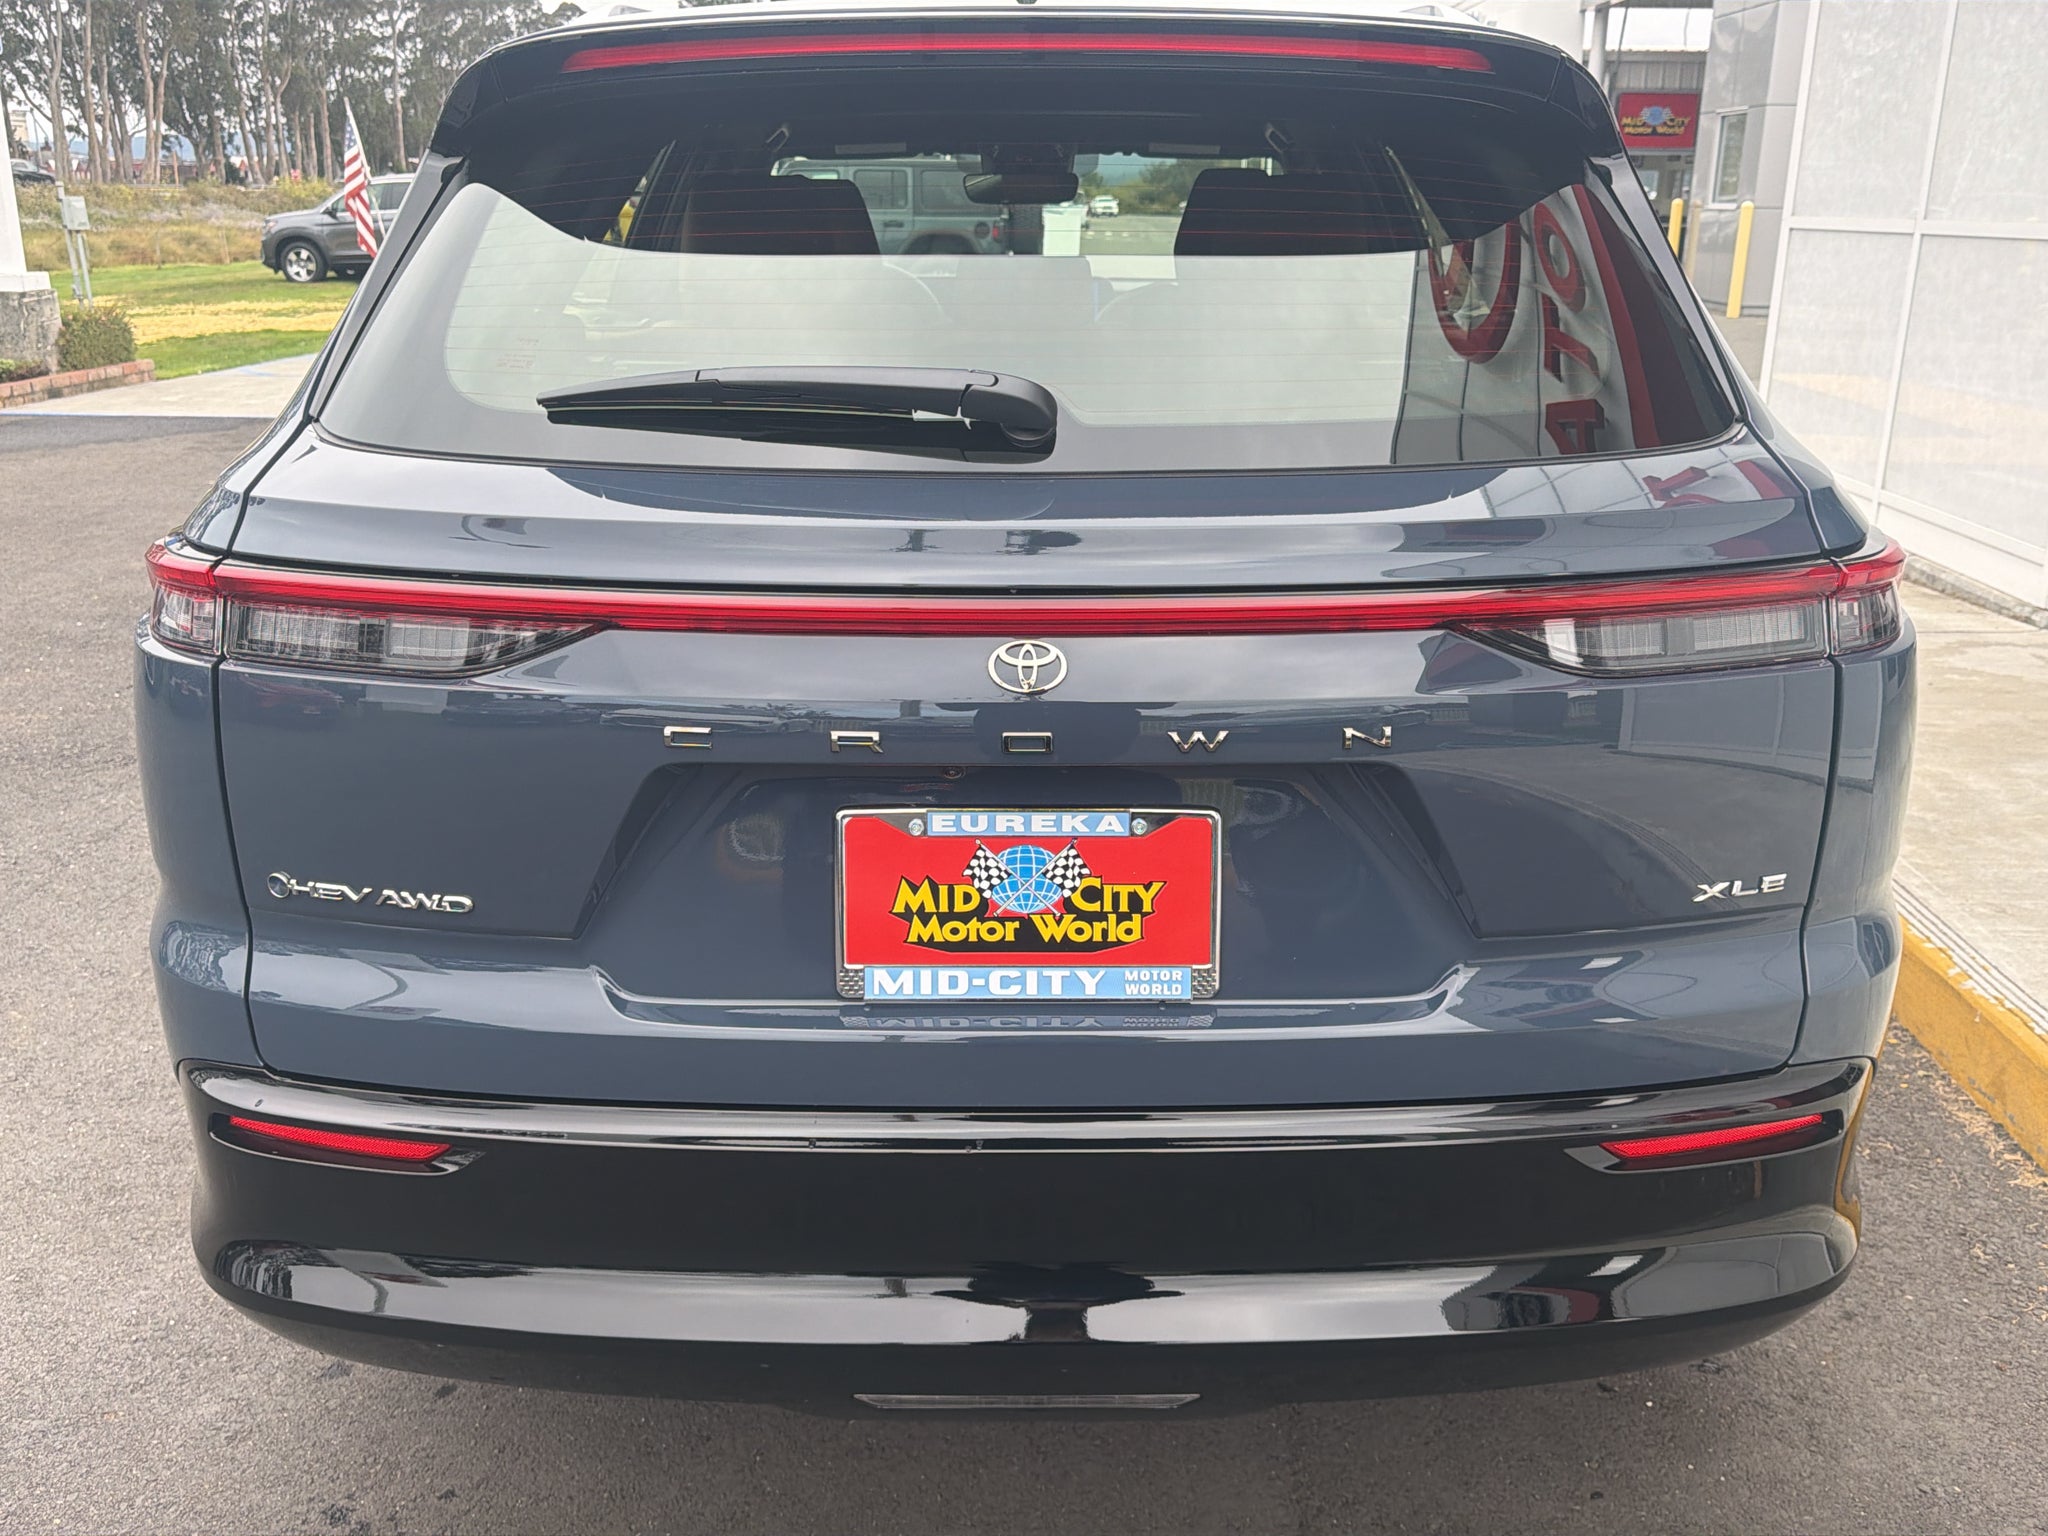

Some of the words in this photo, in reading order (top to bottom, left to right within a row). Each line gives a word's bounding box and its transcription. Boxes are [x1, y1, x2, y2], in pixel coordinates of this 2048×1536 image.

[663, 726, 1393, 754] CROWN
[931, 815, 1125, 833] EUREKA
[892, 878, 981, 913] MID
[1070, 878, 1165, 913] CITY
[1691, 873, 1787, 902] XLE
[376, 890, 474, 913] AWD
[906, 914, 1020, 943] Motor
[1030, 914, 1143, 943] World
[873, 969, 1106, 996] MID-CITY
[1124, 970, 1182, 981] MOTOR
[1125, 983, 1182, 996] WORLD
